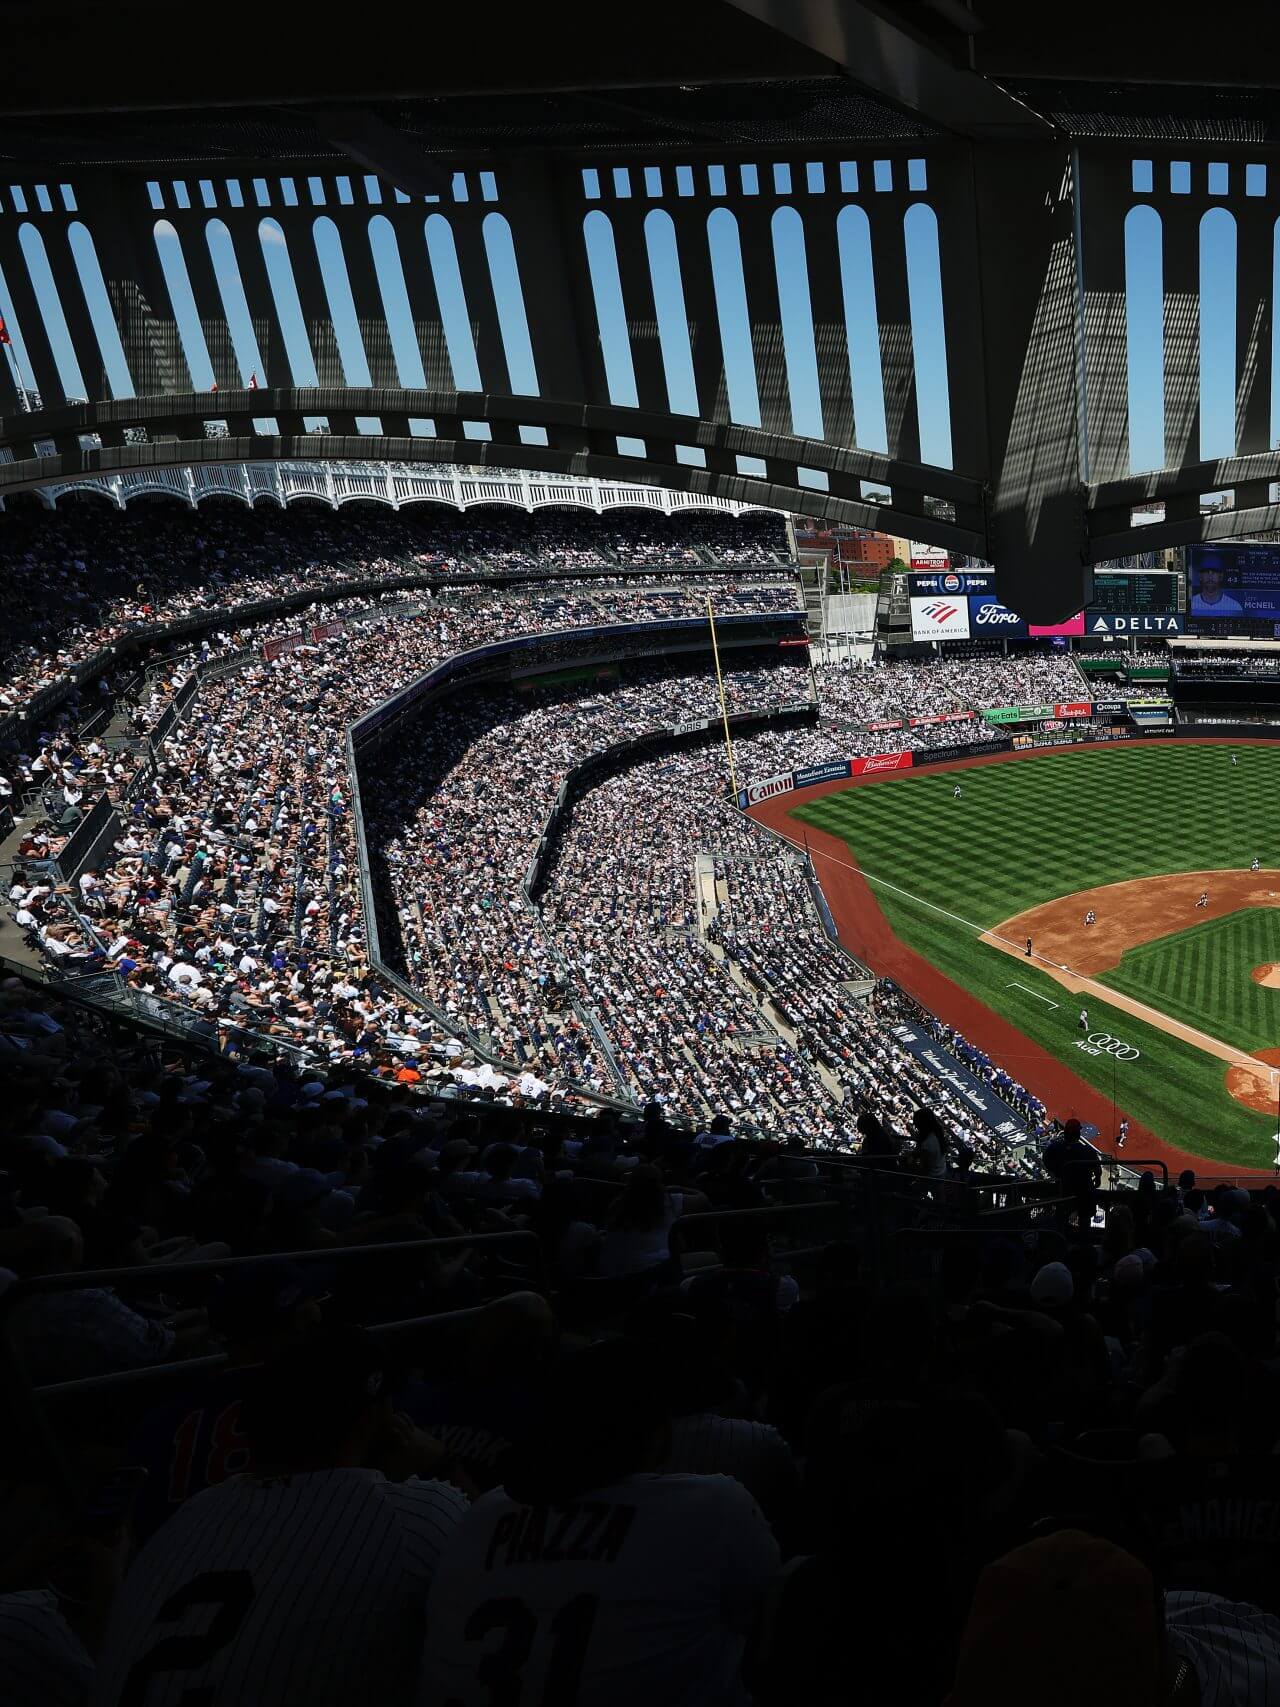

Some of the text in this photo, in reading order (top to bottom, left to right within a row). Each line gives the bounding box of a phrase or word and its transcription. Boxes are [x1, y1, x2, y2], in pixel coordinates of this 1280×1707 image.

[1244, 601, 1276, 610] McNEIL
[1114, 617, 1179, 630] DELTA
[679, 721, 702, 734] ORIS
[923, 749, 958, 761] Spectrum
[749, 777, 793, 802] Canon
[1071, 1039, 1103, 1057] Audi
[485, 1503, 638, 1571] PIAZZA
[119, 1569, 255, 1707] 2
[445, 1592, 598, 1707] 31
